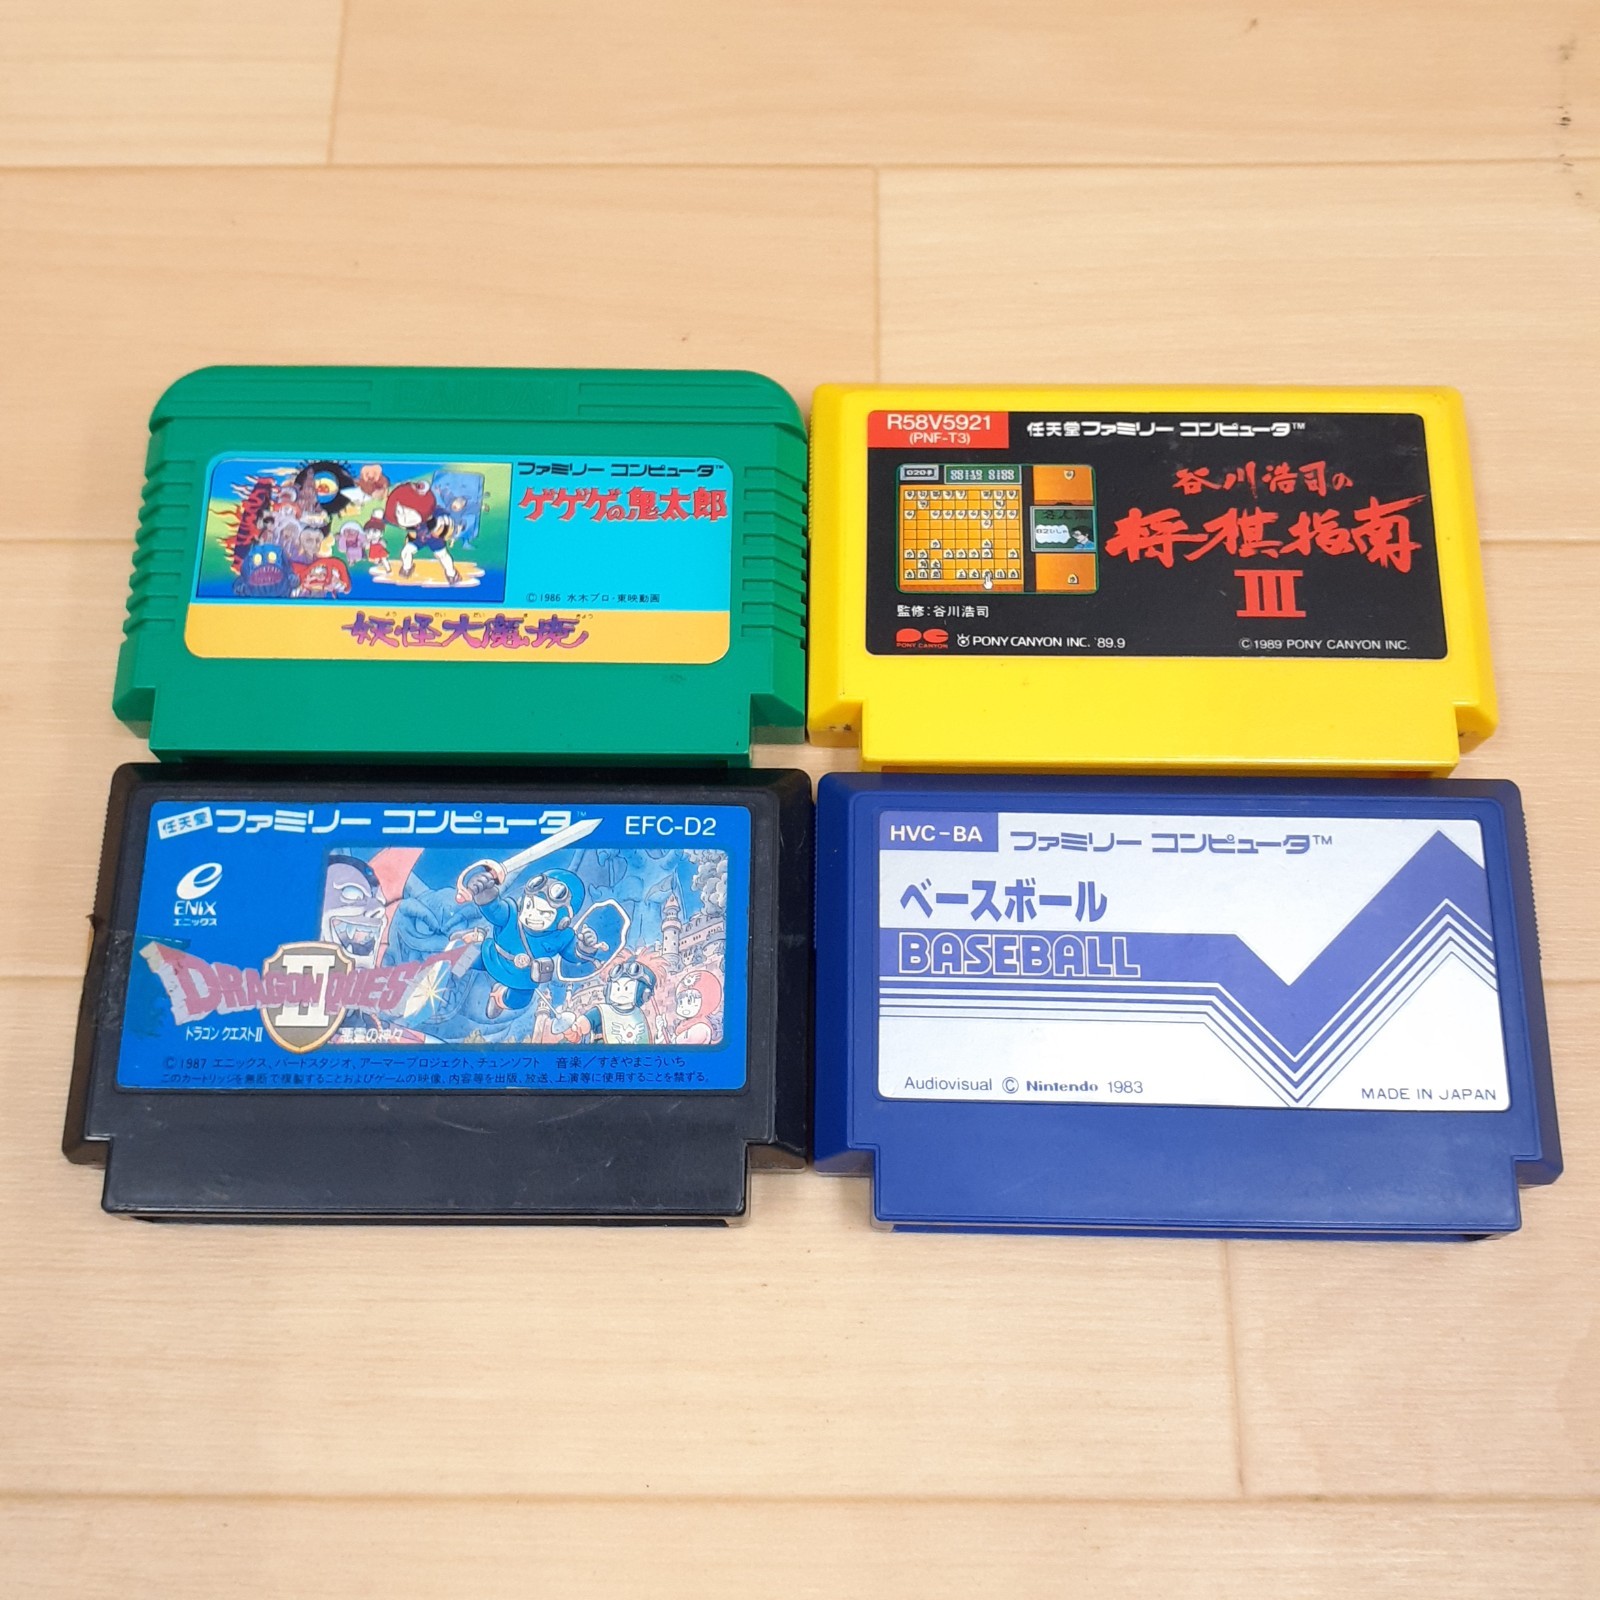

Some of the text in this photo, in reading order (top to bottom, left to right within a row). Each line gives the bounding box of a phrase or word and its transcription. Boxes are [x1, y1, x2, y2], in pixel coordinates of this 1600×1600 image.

[887, 413, 991, 431] R58V5921
[909, 431, 971, 445] (PNF-T3)
[518, 462, 604, 476] ファミリー
[1173, 461, 1354, 498] 谷川浩司の
[518, 486, 728, 522] ゲゲゲの鬼太郎
[1105, 494, 1427, 573] 将棋指南
[341, 610, 589, 649] 妖怪大魔境
[972, 635, 1009, 646] PONY
[1010, 636, 1062, 647] CANYON
[1066, 636, 1091, 647] INC.
[1287, 639, 1322, 649] PONY
[1326, 639, 1381, 650] CANYON
[1385, 640, 1410, 650] INC.
[215, 809, 372, 834] ファミリー
[625, 816, 717, 836] EFC-D2
[890, 824, 983, 843] HVC-BA
[1010, 831, 1142, 852] ファミリー
[173, 900, 217, 916] ENIX
[899, 877, 1108, 923] ベースボール
[173, 918, 217, 927] エニックス
[899, 931, 1141, 979] BASEBALL
[139, 941, 326, 1026] DRAGON
[904, 1076, 993, 1091] Audiovisual
[1026, 1080, 1099, 1093] Nintendo
[1107, 1081, 1144, 1094] 1983
[1361, 1088, 1497, 1101] MADE IN JAPAN
